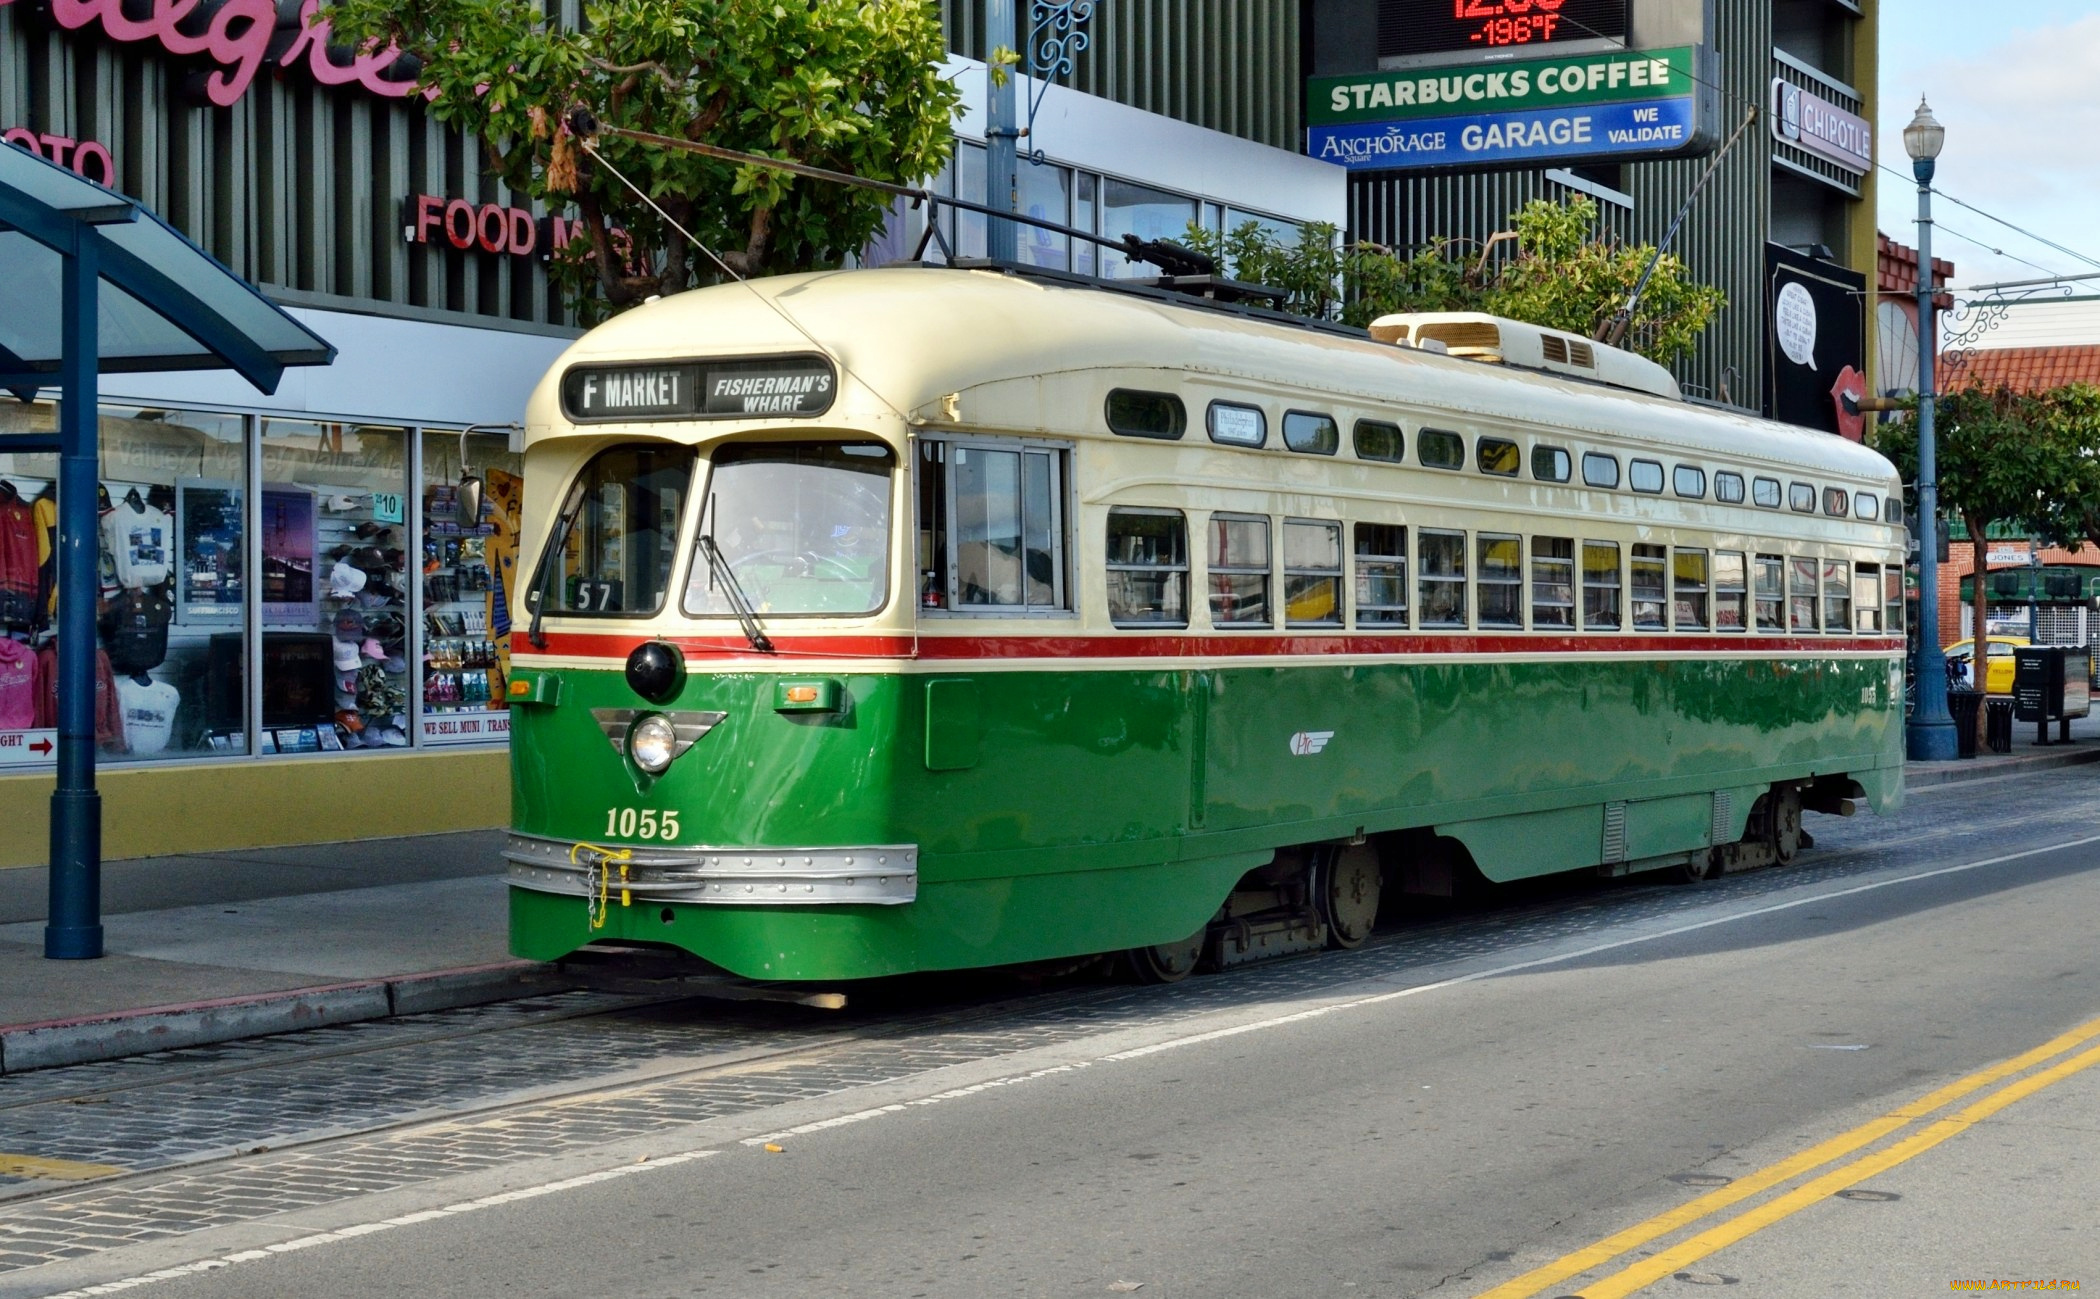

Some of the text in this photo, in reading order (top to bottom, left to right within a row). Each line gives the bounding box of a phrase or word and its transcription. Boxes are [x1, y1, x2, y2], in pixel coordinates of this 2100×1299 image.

[1331, 58, 1670, 112] STARBUCKS COFFEE
[1633, 108, 1659, 123] WE
[1320, 116, 1592, 158] ANCHORAGE GARAGE
[1608, 125, 1682, 144] VALIDATE
[1804, 104, 1871, 159] CHIPOTLE
[1344, 154, 1372, 164] Square
[417, 194, 536, 255] FOOD
[584, 371, 680, 408] F MARKET
[714, 374, 831, 396] FISHERMAN'S
[743, 394, 804, 413] WHARF
[424, 722, 437, 735] WE
[438, 721, 457, 734] SELL
[460, 720, 480, 733] MUNI
[604, 808, 680, 841] 1055
